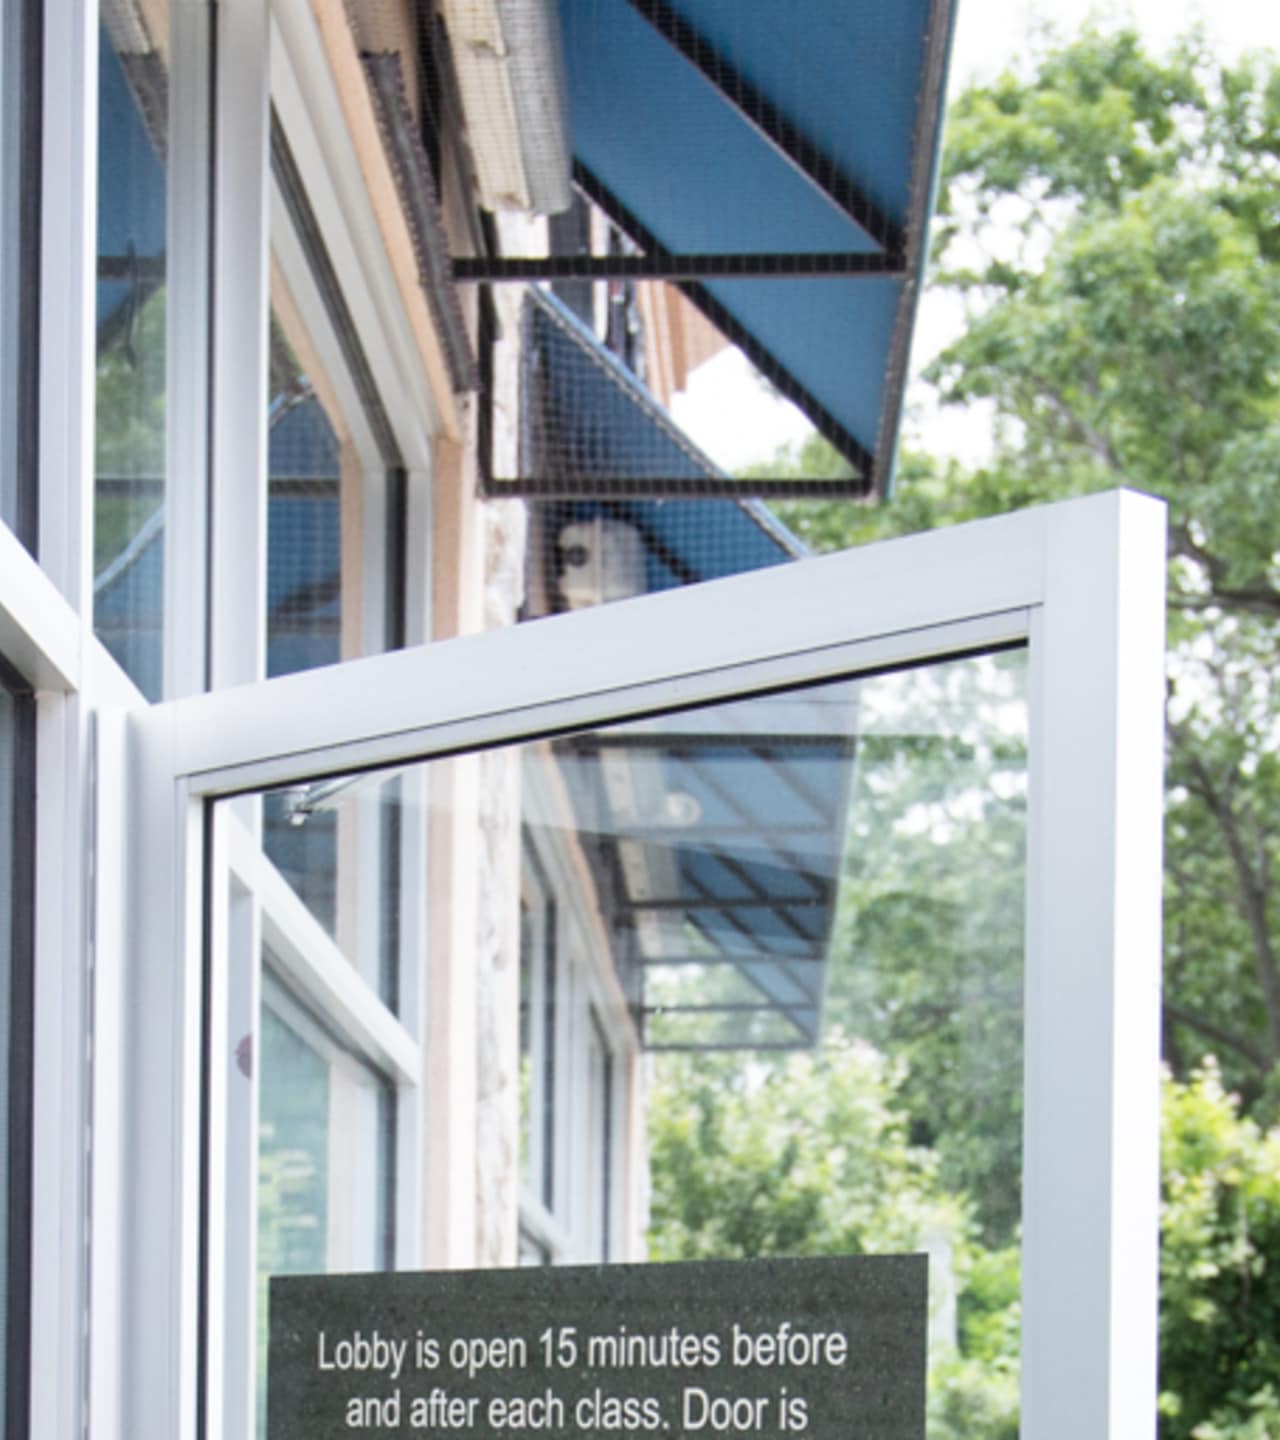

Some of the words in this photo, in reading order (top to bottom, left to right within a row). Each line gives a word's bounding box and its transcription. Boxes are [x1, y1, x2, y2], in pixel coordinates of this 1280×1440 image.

[319, 1330, 407, 1380] Lobby
[416, 1329, 440, 1369] is
[449, 1337, 527, 1379] open
[539, 1327, 578, 1369] 15
[588, 1325, 721, 1367] minutes
[732, 1321, 848, 1367] before
[345, 1388, 401, 1428] and
[409, 1387, 480, 1429] after
[488, 1388, 564, 1429] each
[575, 1387, 670, 1430] class.
[683, 1387, 769, 1431] Door
[779, 1386, 808, 1431] is
